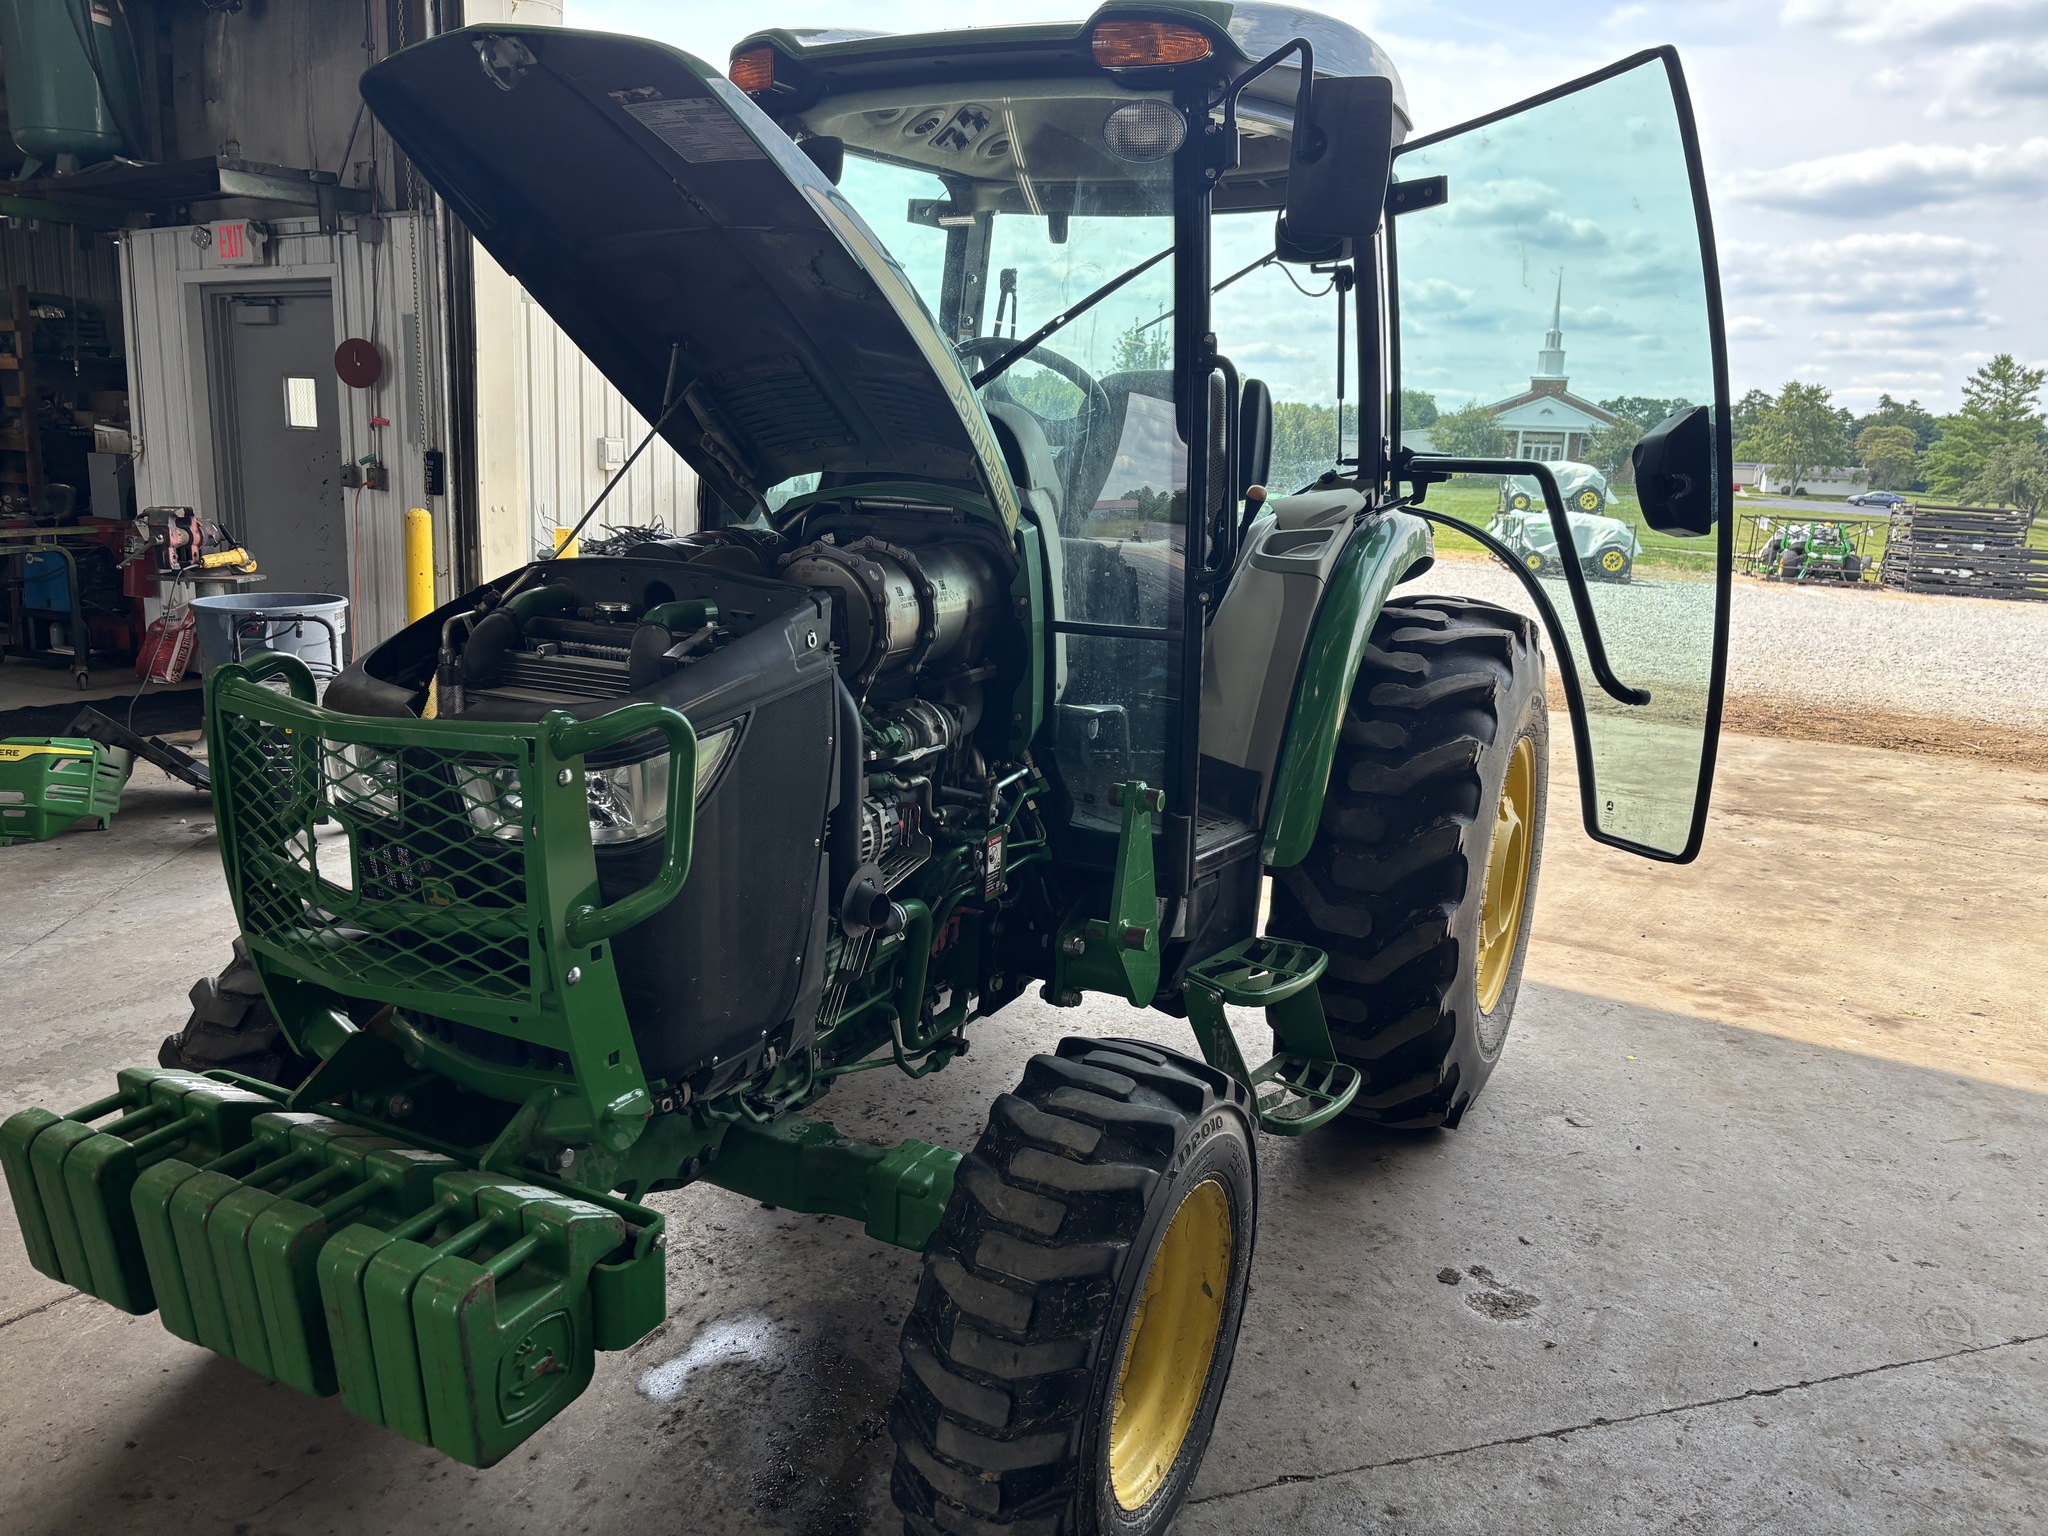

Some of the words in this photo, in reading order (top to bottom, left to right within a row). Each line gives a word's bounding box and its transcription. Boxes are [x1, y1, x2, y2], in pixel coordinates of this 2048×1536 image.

[219, 224, 245, 259] EXIT
[951, 384, 985, 451] JOHN
[980, 442, 1012, 522] DEERE
